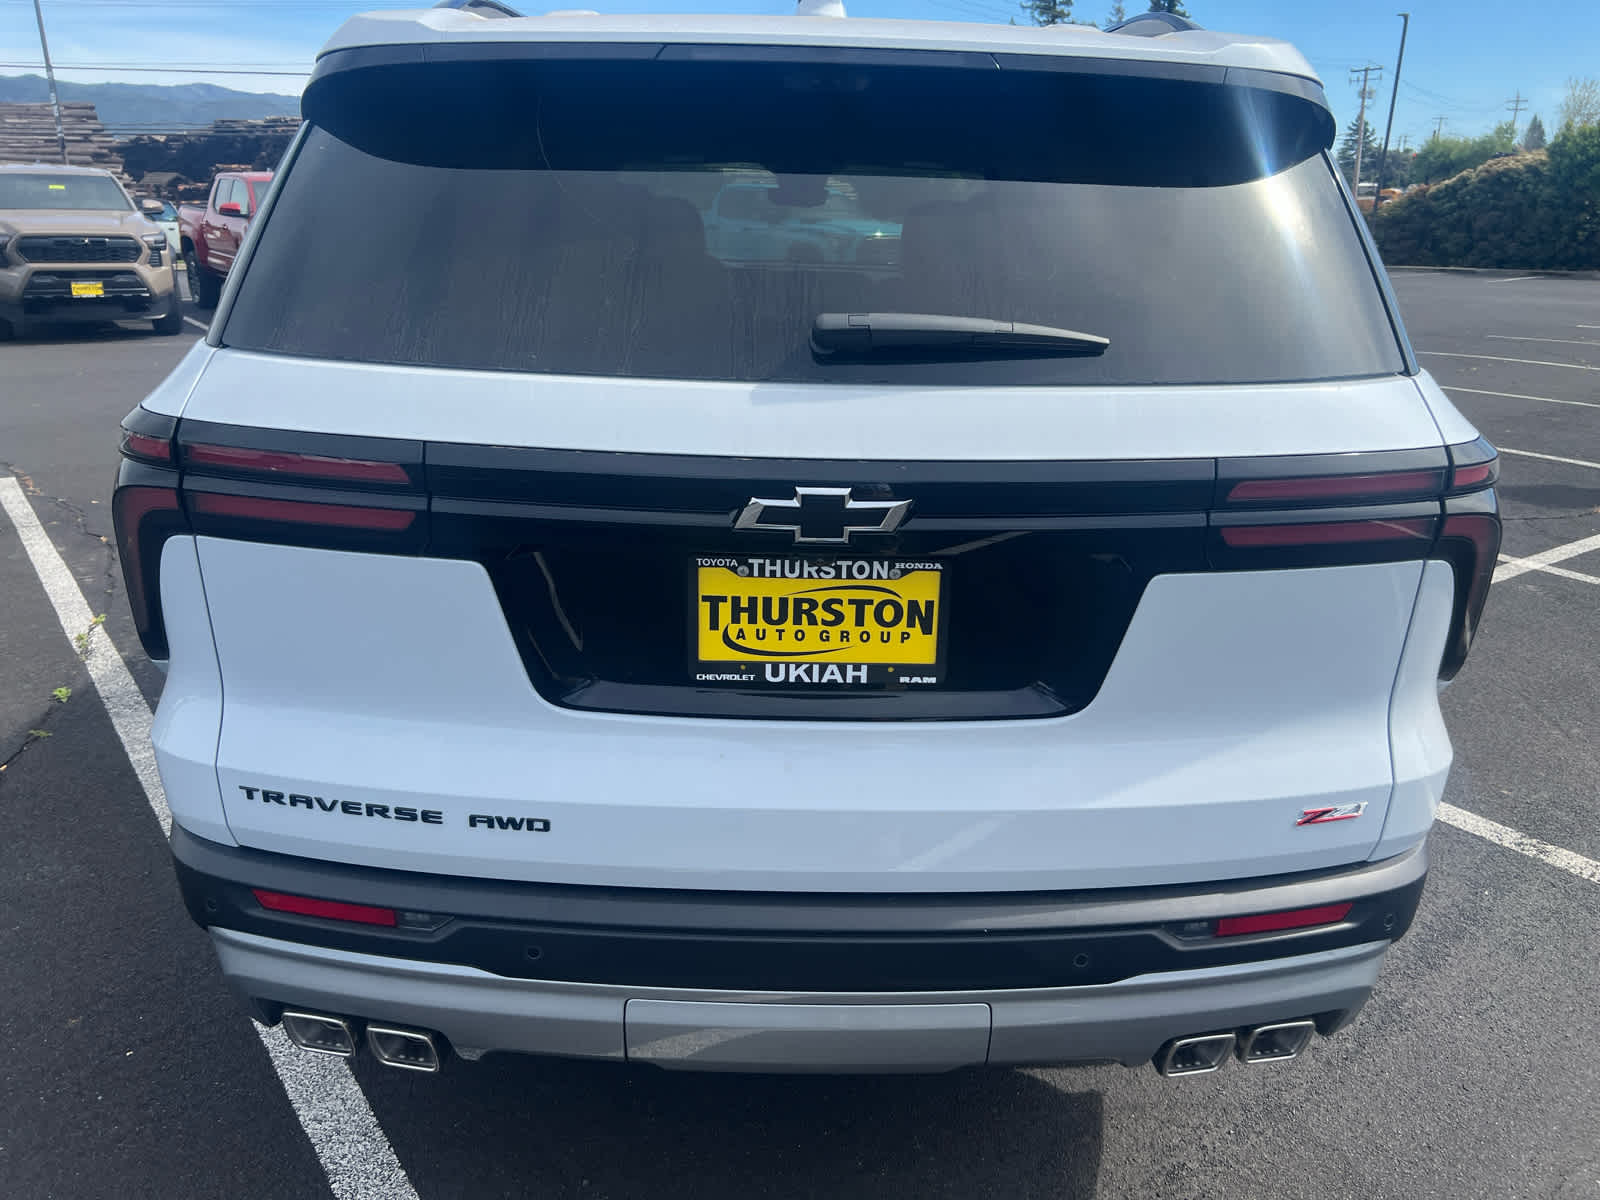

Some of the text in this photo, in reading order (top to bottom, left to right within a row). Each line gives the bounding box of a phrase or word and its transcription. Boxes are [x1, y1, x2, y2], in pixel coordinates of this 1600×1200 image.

[696, 558, 738, 567] TOYOTA
[748, 559, 889, 580] THURSTON
[895, 562, 943, 570] HONDA
[701, 595, 935, 636] THURSTON
[735, 628, 911, 644] AUTO GROUP
[696, 673, 756, 681] CHEVROLET
[765, 663, 868, 684] UKIAH
[899, 676, 937, 684] RAM
[239, 785, 551, 833] TRAVERSE AWD
